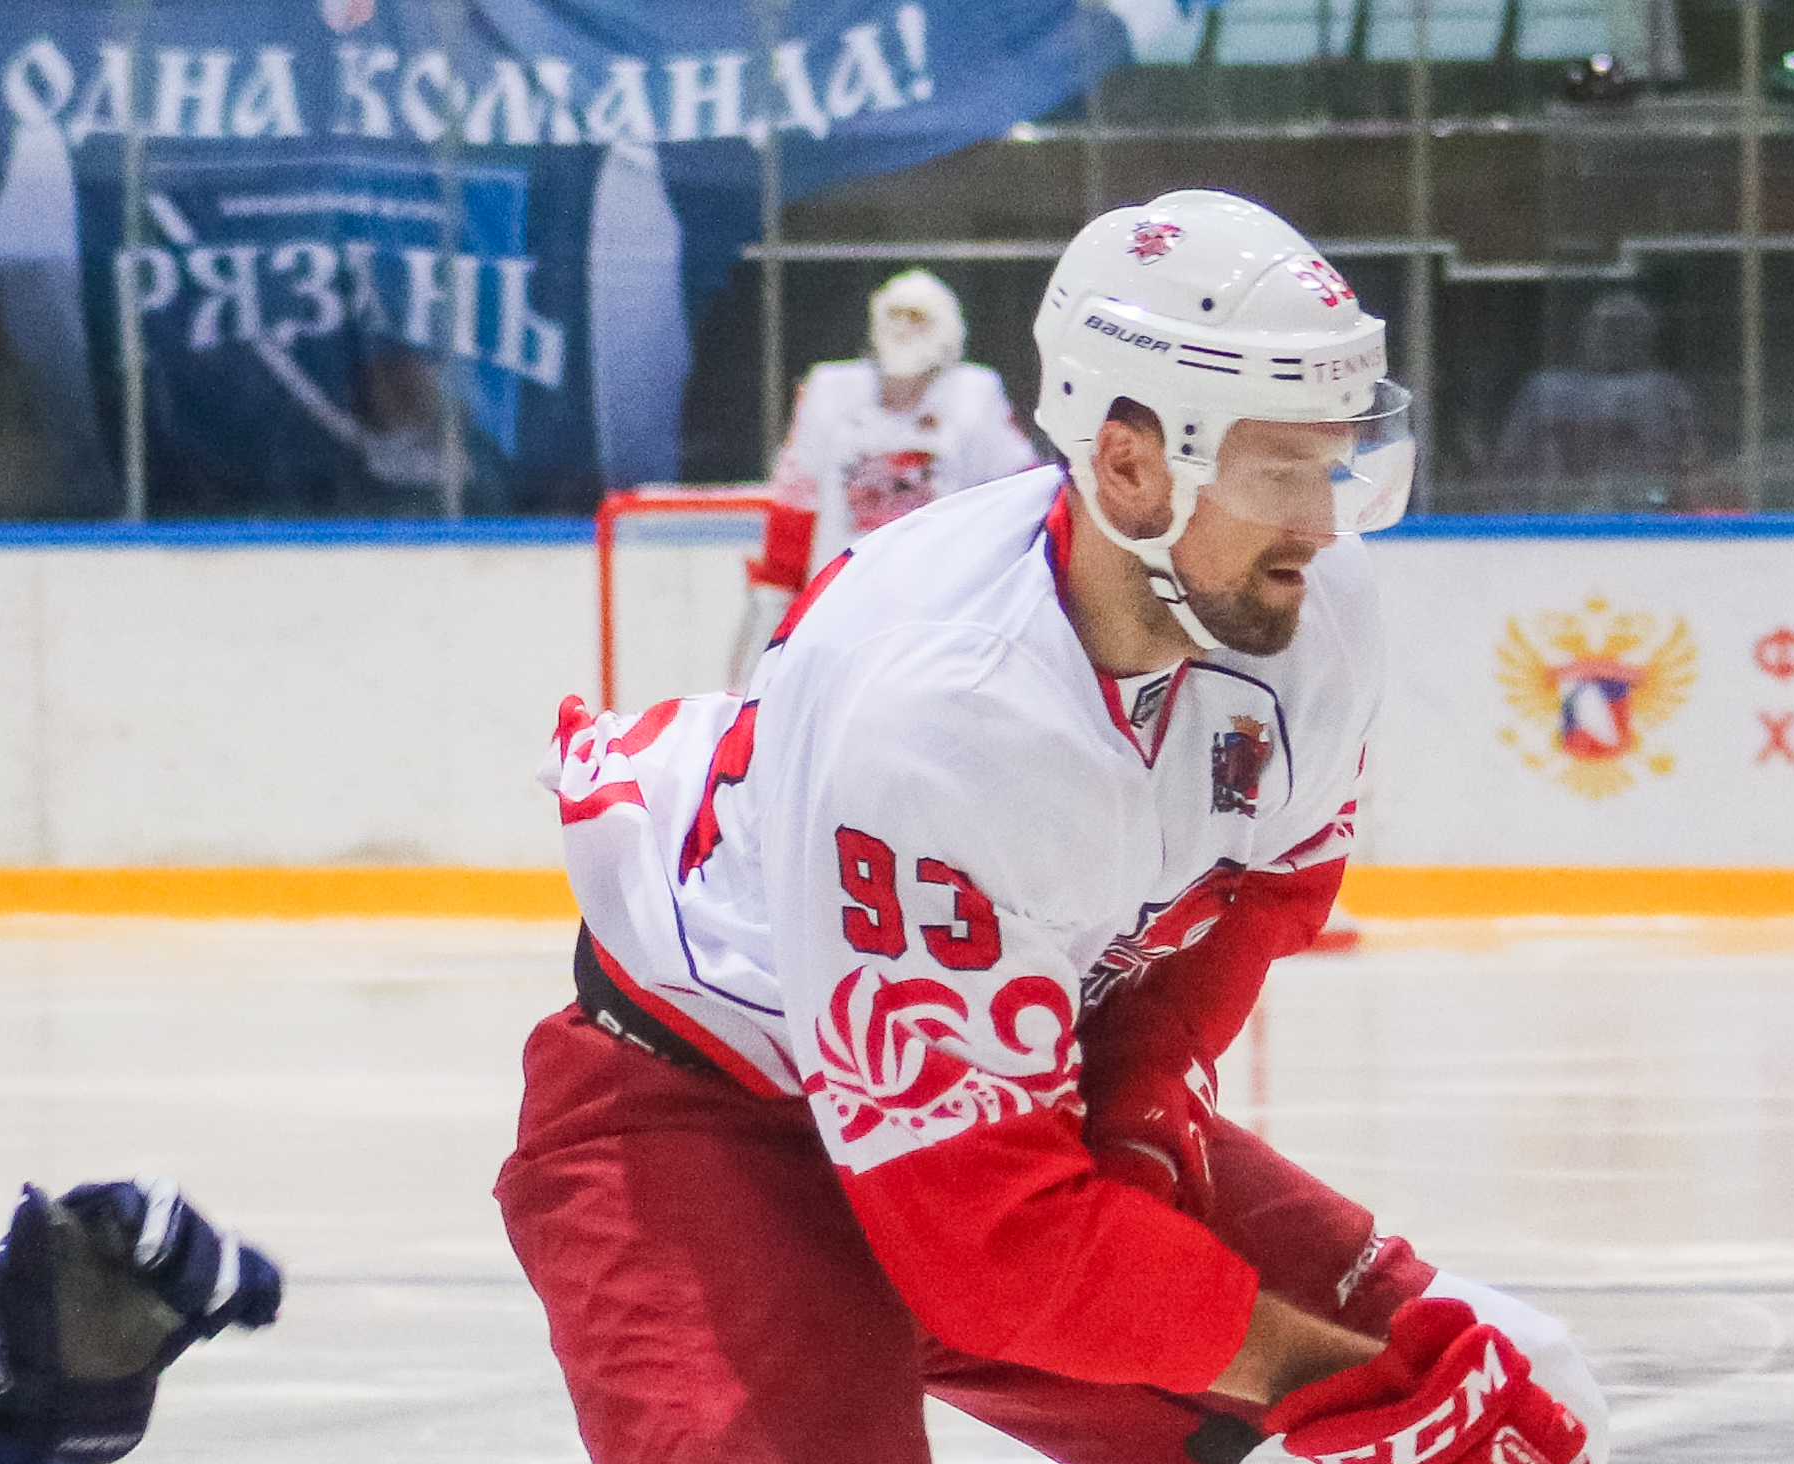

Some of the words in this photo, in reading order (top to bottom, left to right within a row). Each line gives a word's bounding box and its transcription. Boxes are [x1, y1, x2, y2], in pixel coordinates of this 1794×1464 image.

[4, 38, 304, 143] ОДНА
[332, 6, 934, 148] КОМАНДА!
[834, 823, 1004, 972] 93
